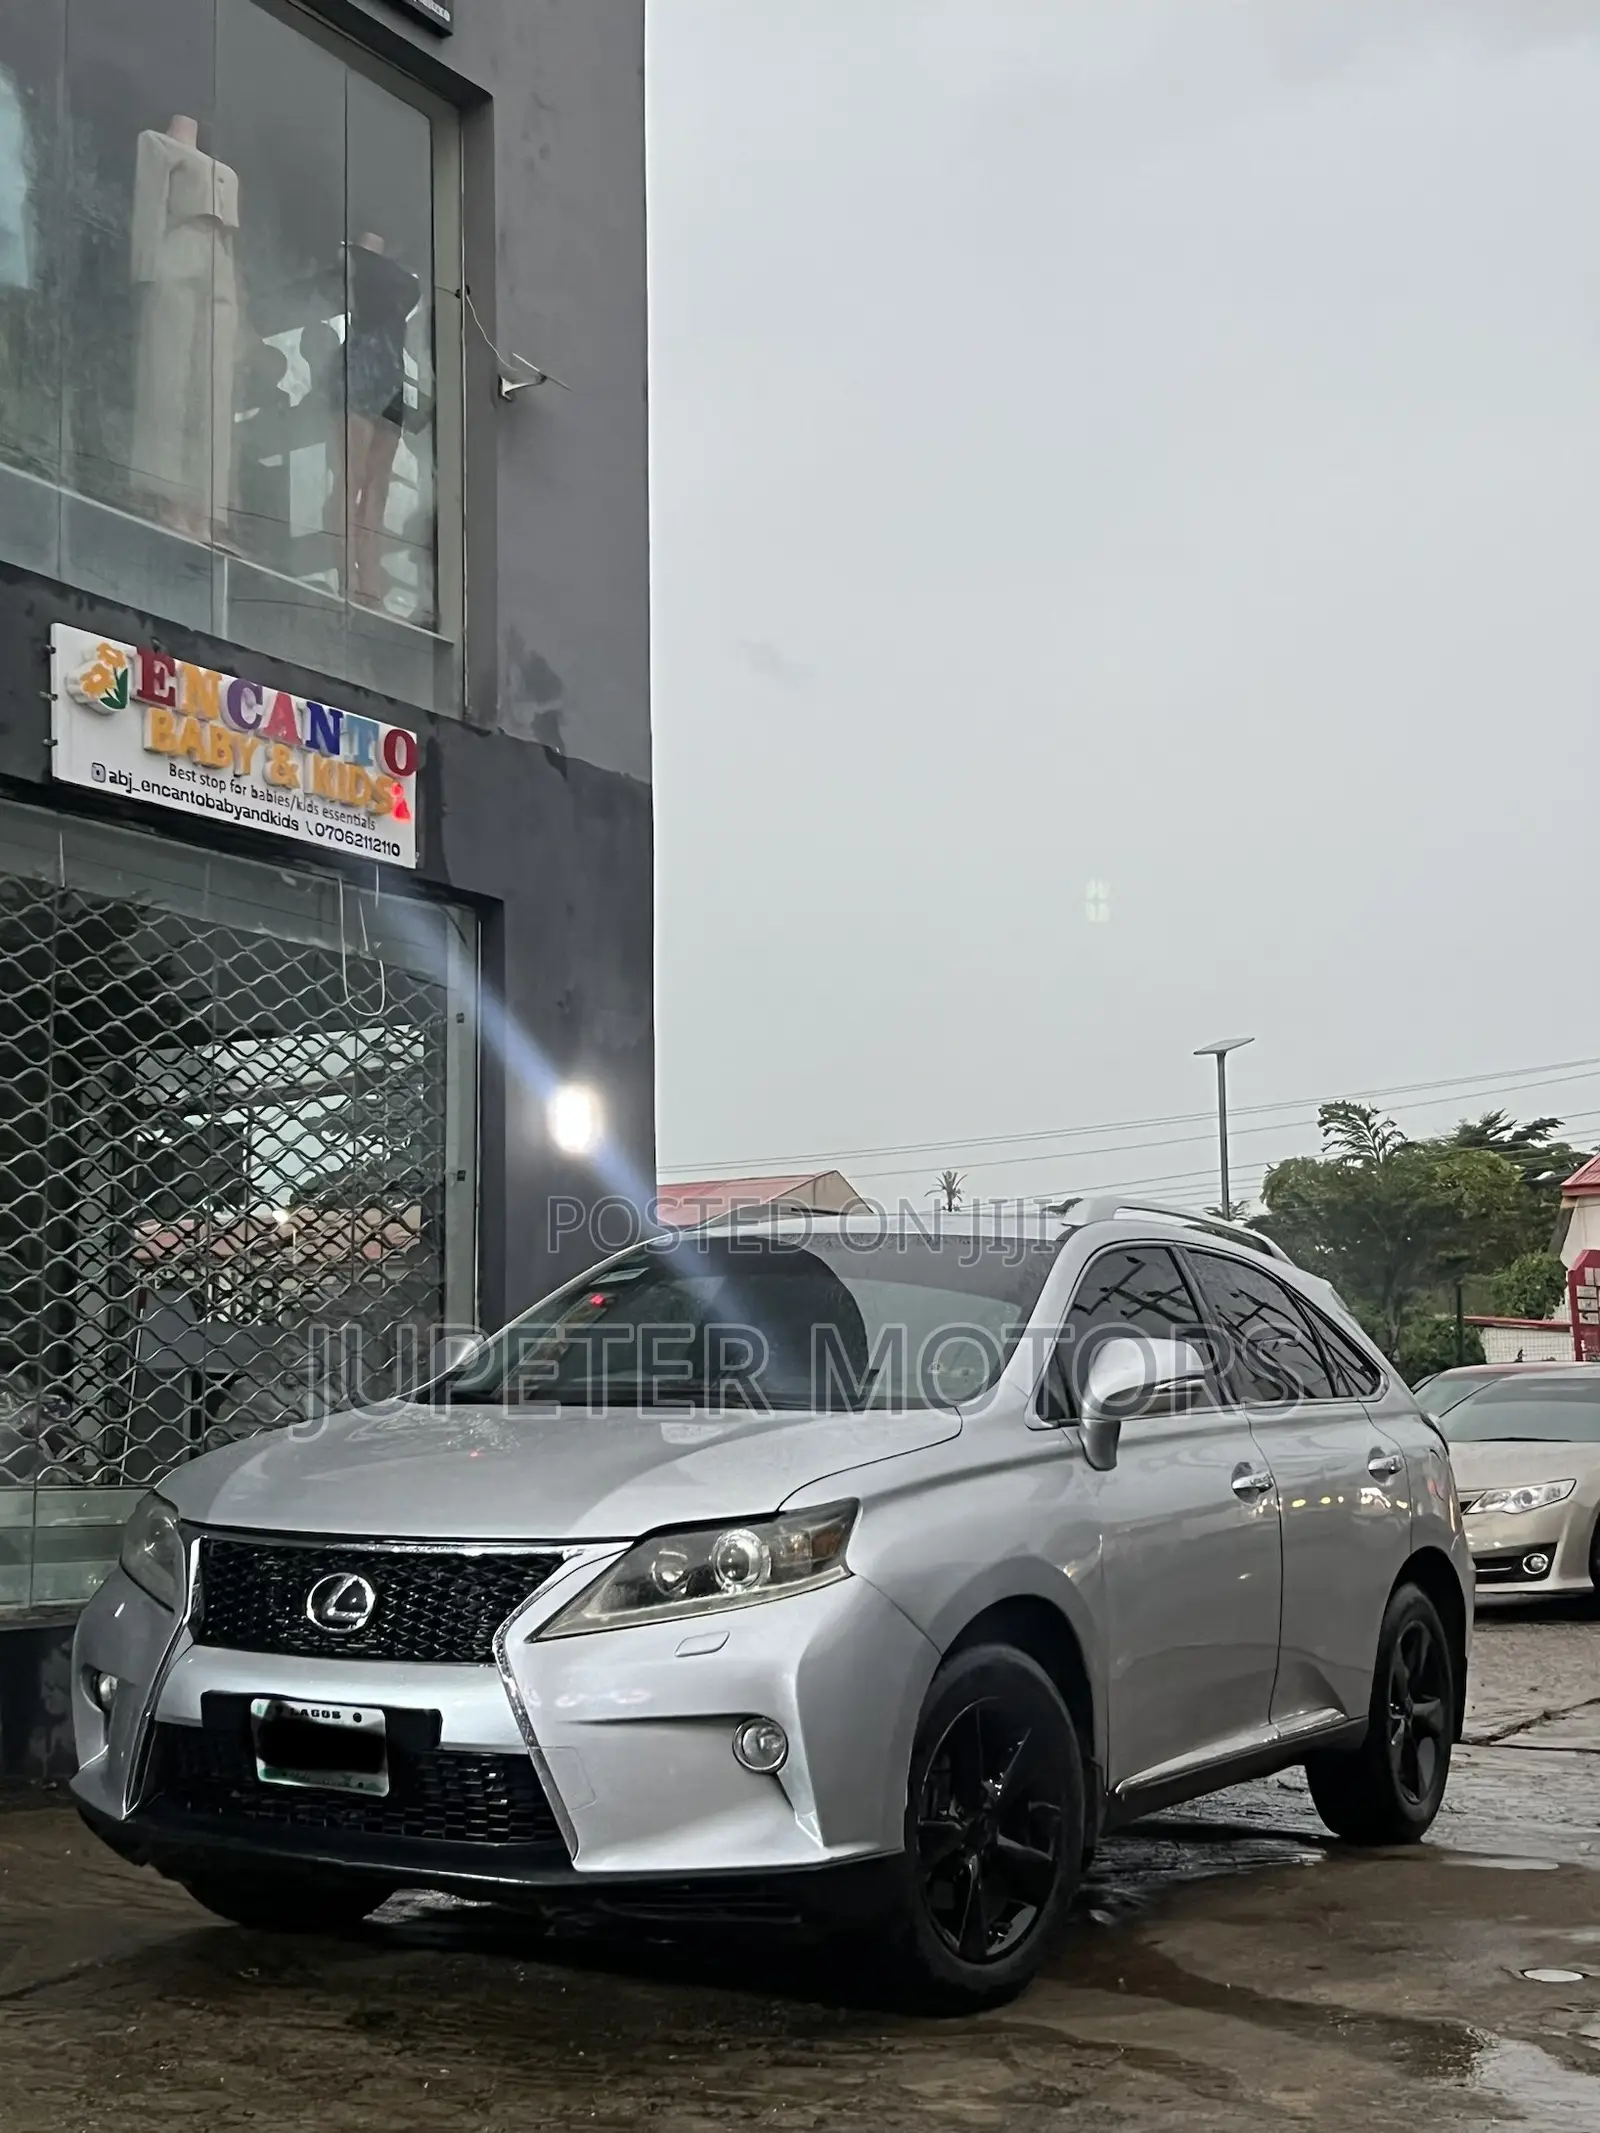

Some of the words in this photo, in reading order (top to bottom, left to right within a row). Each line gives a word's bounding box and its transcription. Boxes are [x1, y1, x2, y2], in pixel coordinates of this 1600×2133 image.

[135, 646, 418, 777] ENCANTO
[145, 707, 260, 776] BABY
[264, 744, 300, 789] &
[304, 755, 396, 817] KIDS
[169, 763, 196, 783] Best
[200, 773, 226, 793] stop
[230, 779, 247, 795] for
[251, 784, 319, 815] babies/kids
[323, 806, 376, 831] essentials
[315, 823, 401, 857] 07062112110
[290, 1707, 342, 1720] LAGOS
